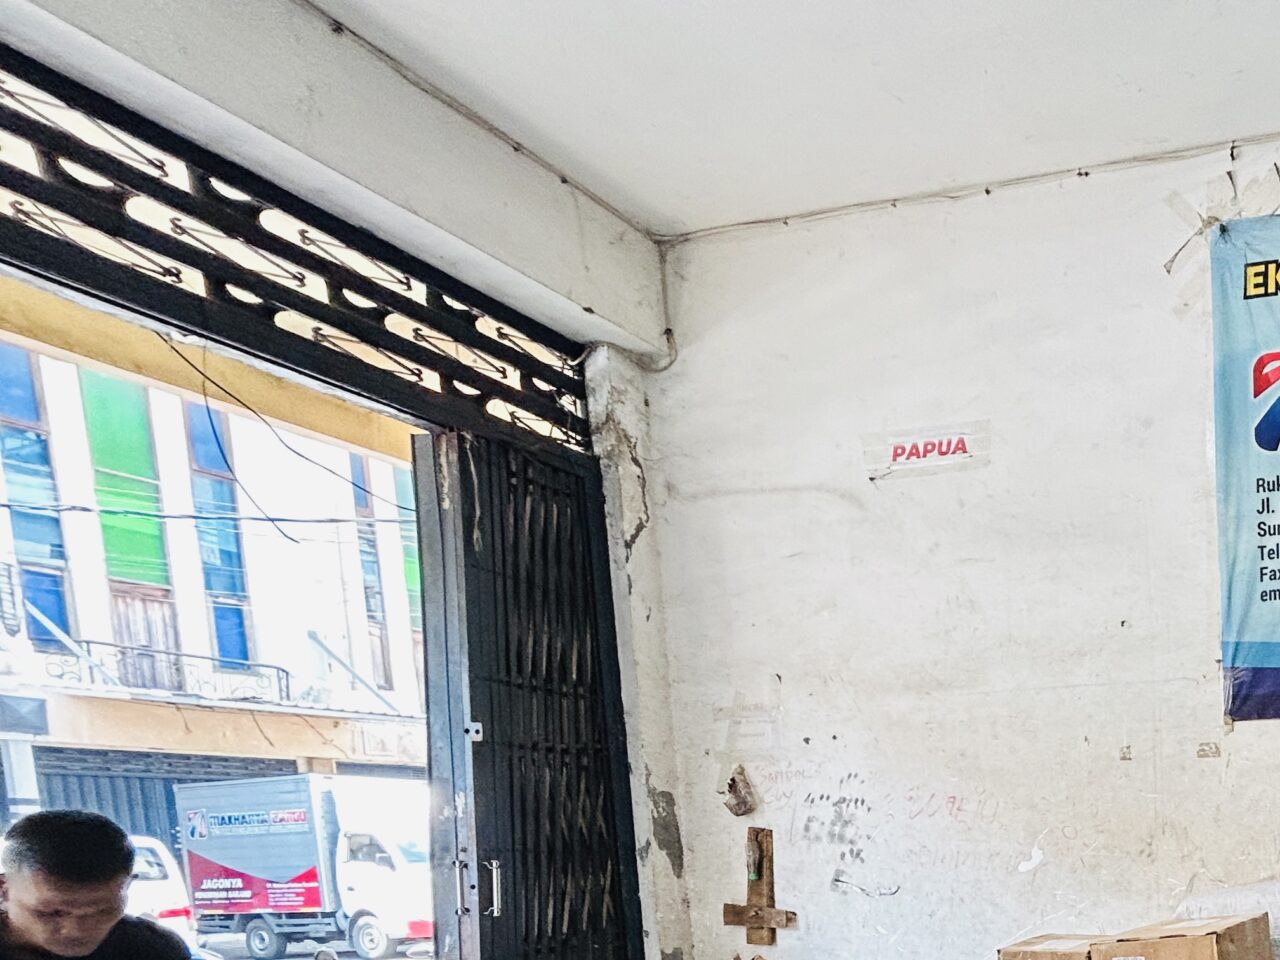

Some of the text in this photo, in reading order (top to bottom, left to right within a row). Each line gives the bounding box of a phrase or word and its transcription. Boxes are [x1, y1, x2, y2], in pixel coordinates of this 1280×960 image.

[892, 437, 968, 462] PAPUA
[1256, 497, 1275, 515] Jl.
[201, 878, 243, 889] JAGONYA
